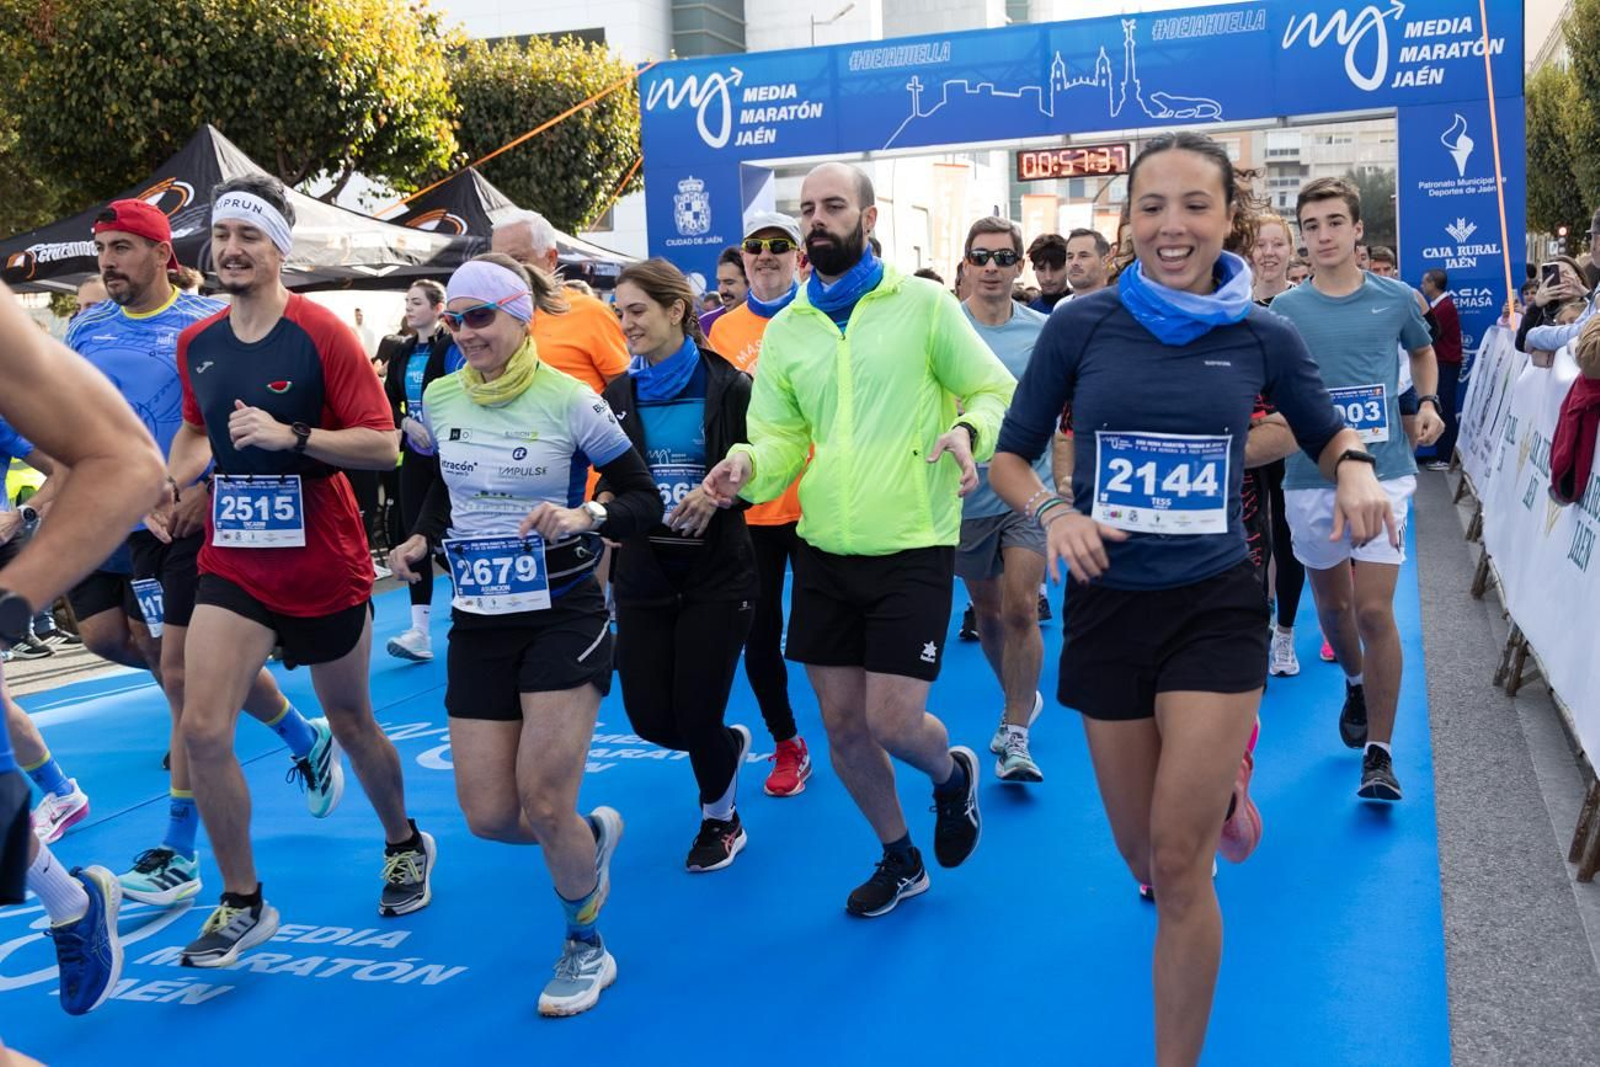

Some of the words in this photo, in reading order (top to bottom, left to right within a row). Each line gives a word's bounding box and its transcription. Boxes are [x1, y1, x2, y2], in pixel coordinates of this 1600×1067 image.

[1152, 9, 1266, 41] #DEJAHUELLA
[1404, 16, 1472, 38] MEDIA
[849, 41, 951, 71] #DEJAHUELLA
[1399, 35, 1505, 63] MARATÓN
[1391, 66, 1444, 88] JAÉN
[743, 83, 797, 103] MEDIA
[739, 101, 823, 124] MARATÓN
[734, 126, 776, 146] JAÉN
[1023, 147, 1126, 178] 00:57:37
[1418, 179, 1456, 190] Patronato
[1457, 176, 1495, 186] Municipal
[1428, 187, 1464, 197] Deportes
[1465, 186, 1476, 194] de
[1477, 184, 1497, 193] Jaén
[665, 237, 693, 247] CIUDAD
[694, 237, 703, 245] DE
[705, 234, 723, 244] JAÉN
[1423, 246, 1454, 259] CAJA
[1457, 243, 1501, 257] RURAL
[1445, 256, 1477, 270] JAÉN
[1106, 457, 1219, 498] 2144
[220, 495, 296, 521] 2515
[1151, 496, 1172, 507] TESS
[457, 554, 537, 586] 2679
[266, 924, 412, 949] EDIA
